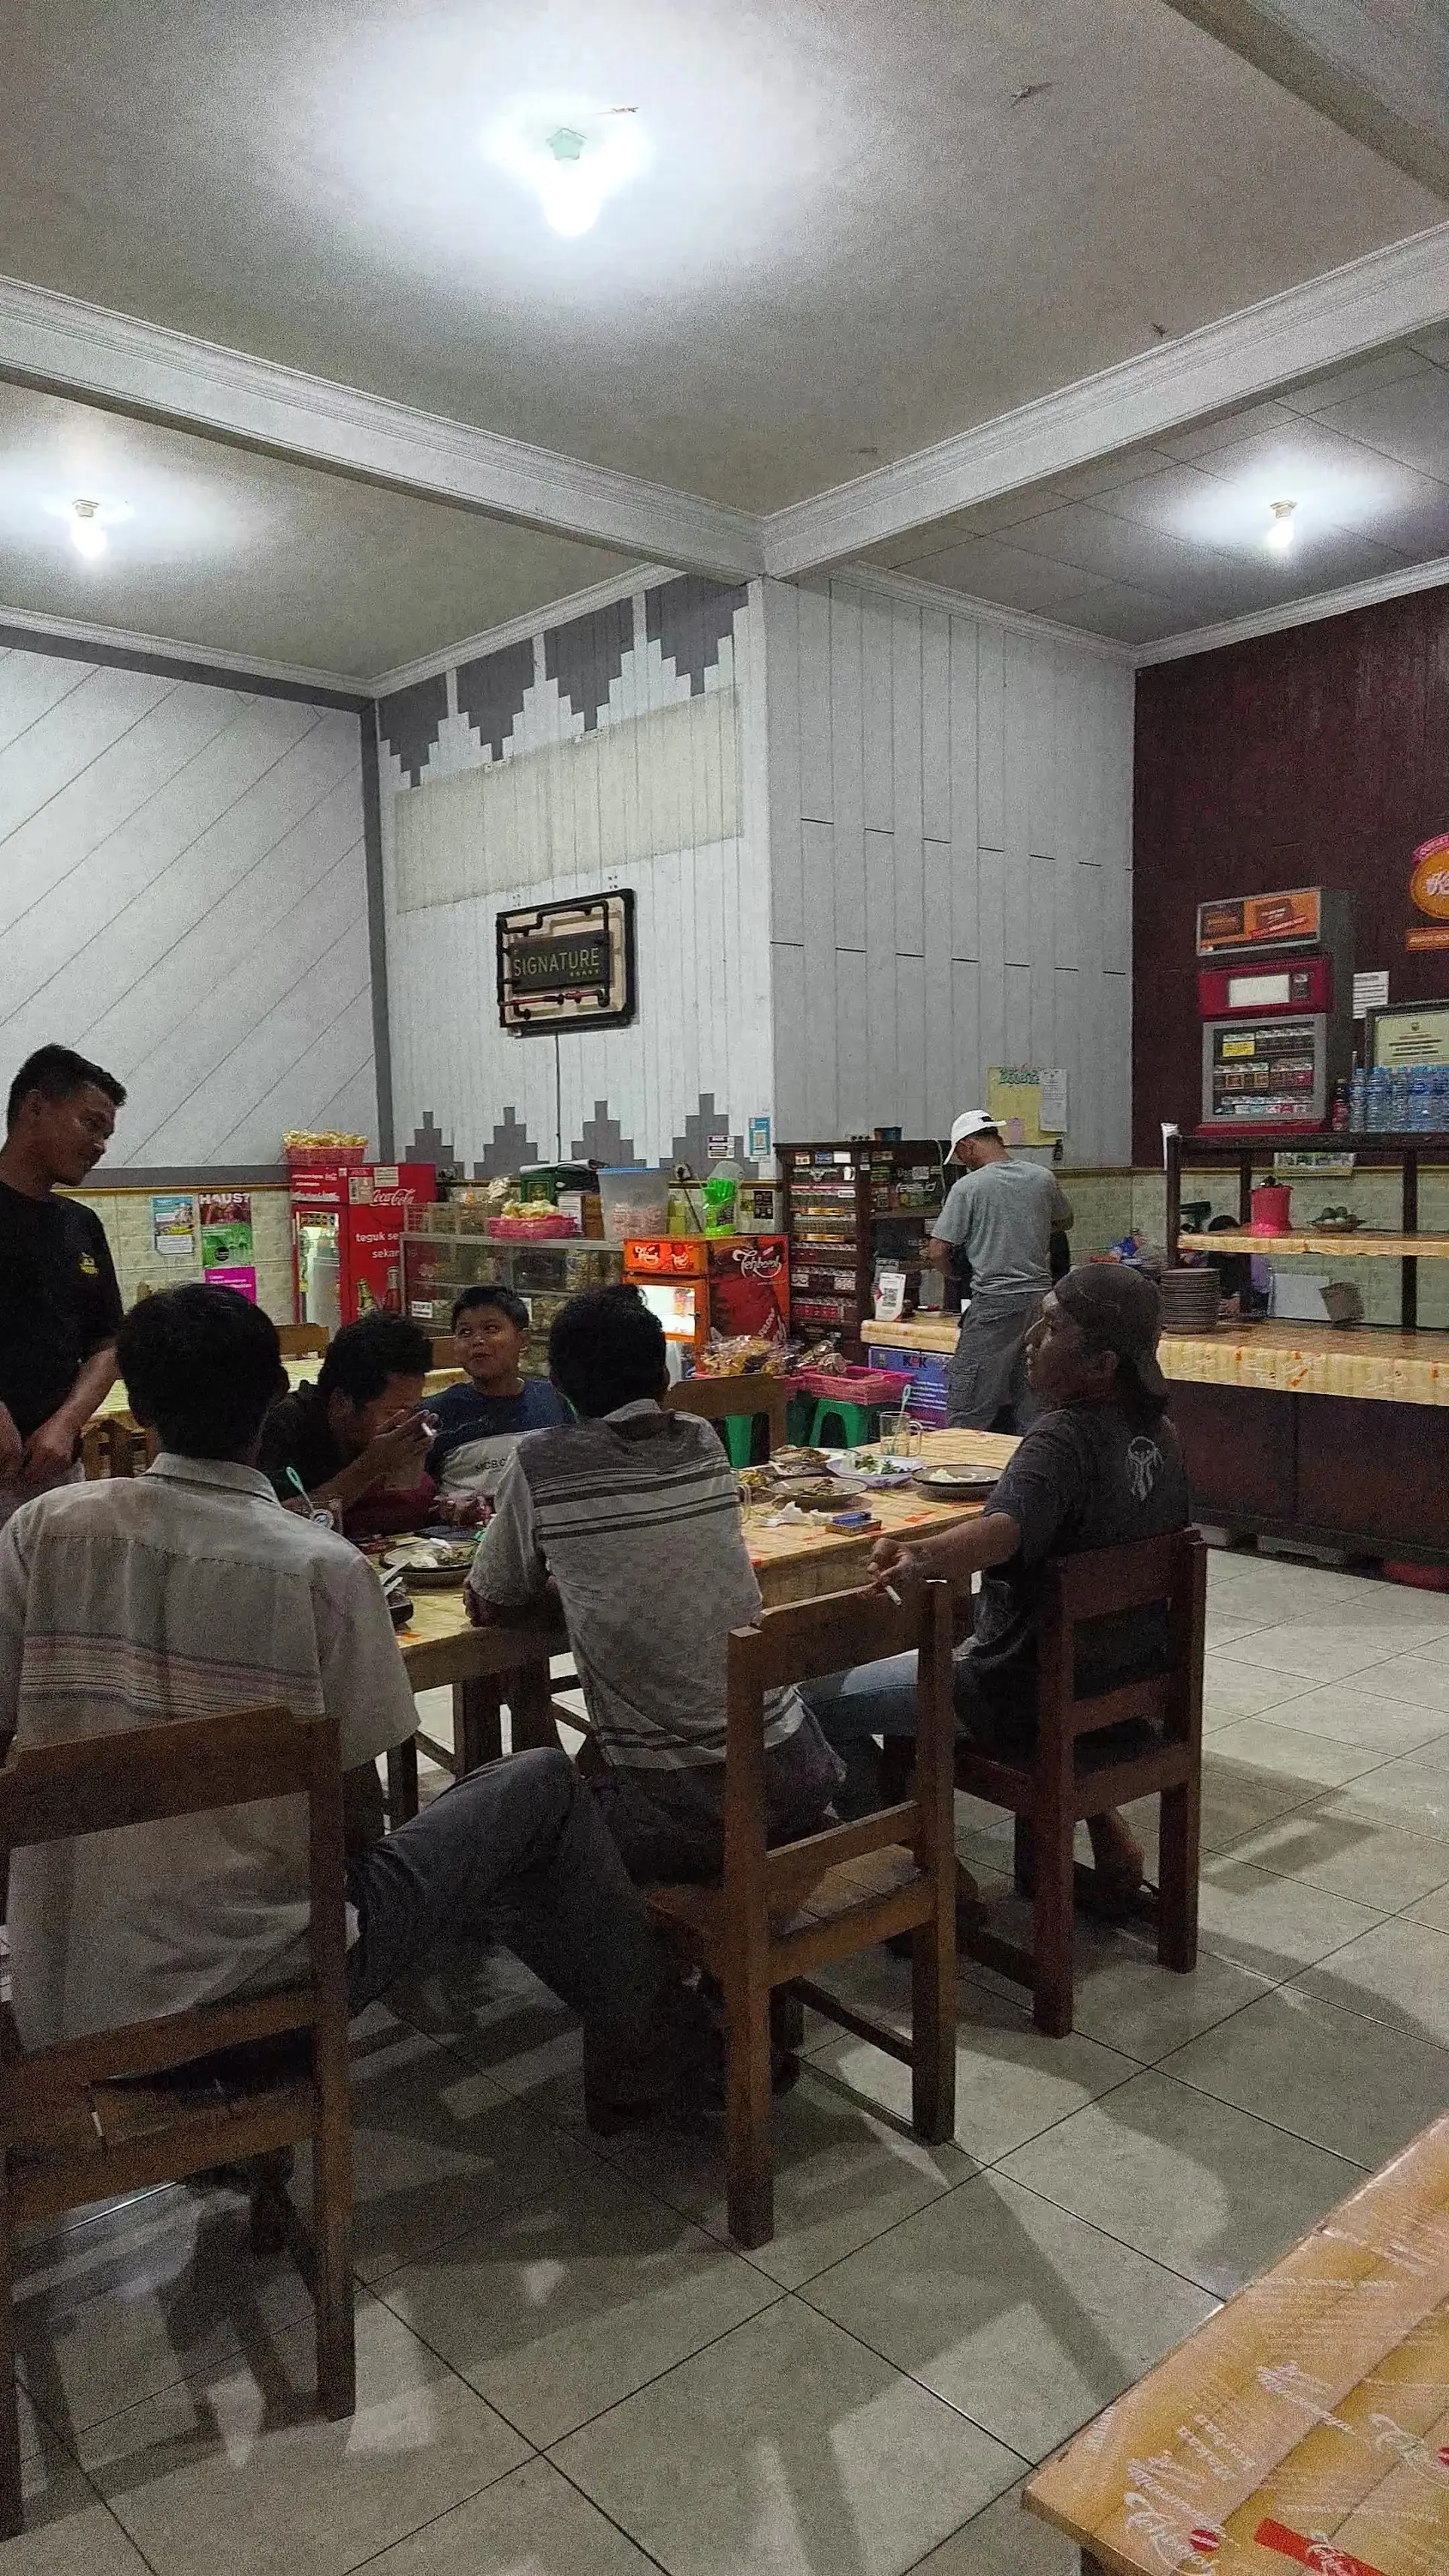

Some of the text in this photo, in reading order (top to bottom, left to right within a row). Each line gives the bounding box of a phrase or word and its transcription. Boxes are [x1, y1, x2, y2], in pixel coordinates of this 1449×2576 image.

[513, 947, 599, 977] SIGNATURE
[198, 1193, 250, 1205] HAUS?
[355, 1231, 386, 1243] teguk
